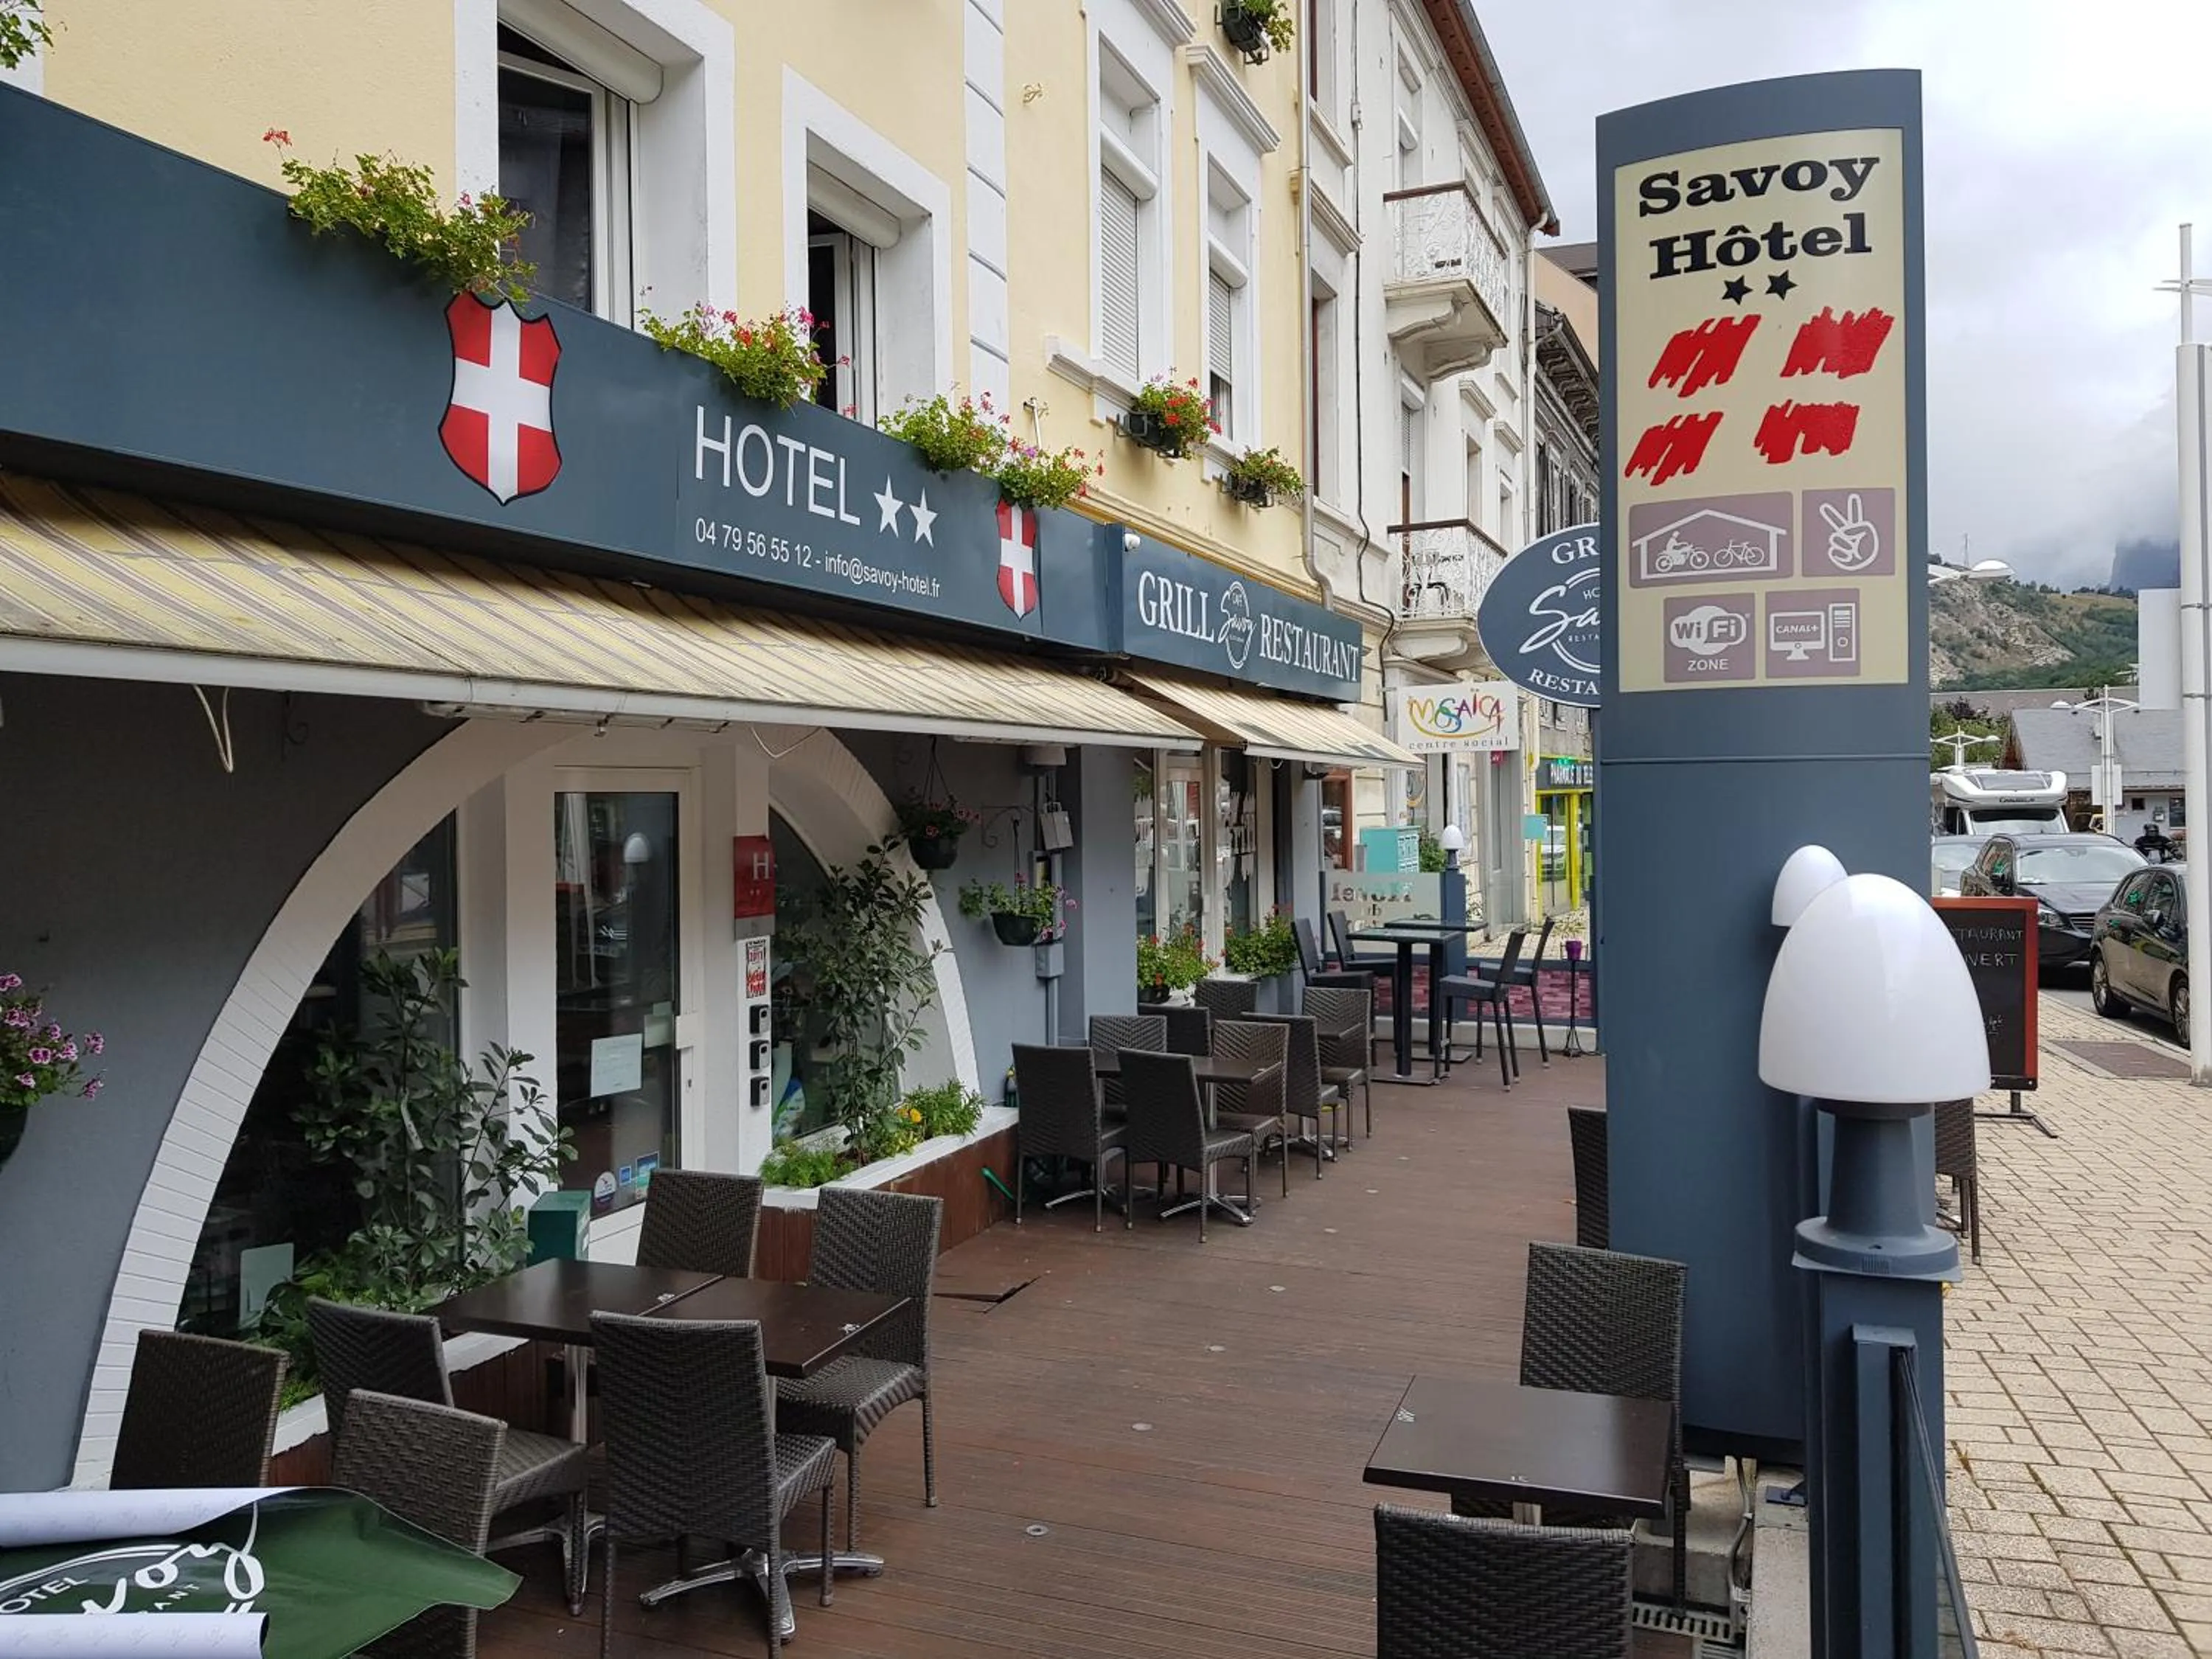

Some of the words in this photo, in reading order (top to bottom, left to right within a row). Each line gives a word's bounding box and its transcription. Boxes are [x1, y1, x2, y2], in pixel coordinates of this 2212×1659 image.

[1639, 157, 1880, 217] Savoy
[1649, 212, 1872, 279] Hôtel
[695, 405, 860, 526] HOTEL
[695, 518, 716, 545] 04
[722, 524, 742, 552] 79
[746, 531, 766, 557] 56
[771, 538, 790, 563] 55
[794, 543, 812, 568] 12
[825, 551, 940, 598] info@savoy-hotel.fr
[1551, 536, 1600, 564] GR
[1138, 571, 1214, 643] GRILL
[1519, 585, 1600, 653] Sa
[1568, 633, 1600, 643] RESTA
[1775, 625, 1819, 634] CANAL+
[1259, 613, 1359, 683] RESTAURANT
[1688, 658, 1729, 672] ZONE
[1528, 668, 1600, 695] RESTA
[1409, 741, 1457, 750] centre
[1464, 737, 1508, 747] social
[753, 852, 769, 880] H
[1955, 928, 2024, 944] TAURANT
[0, 1576, 89, 1613] OTEL
